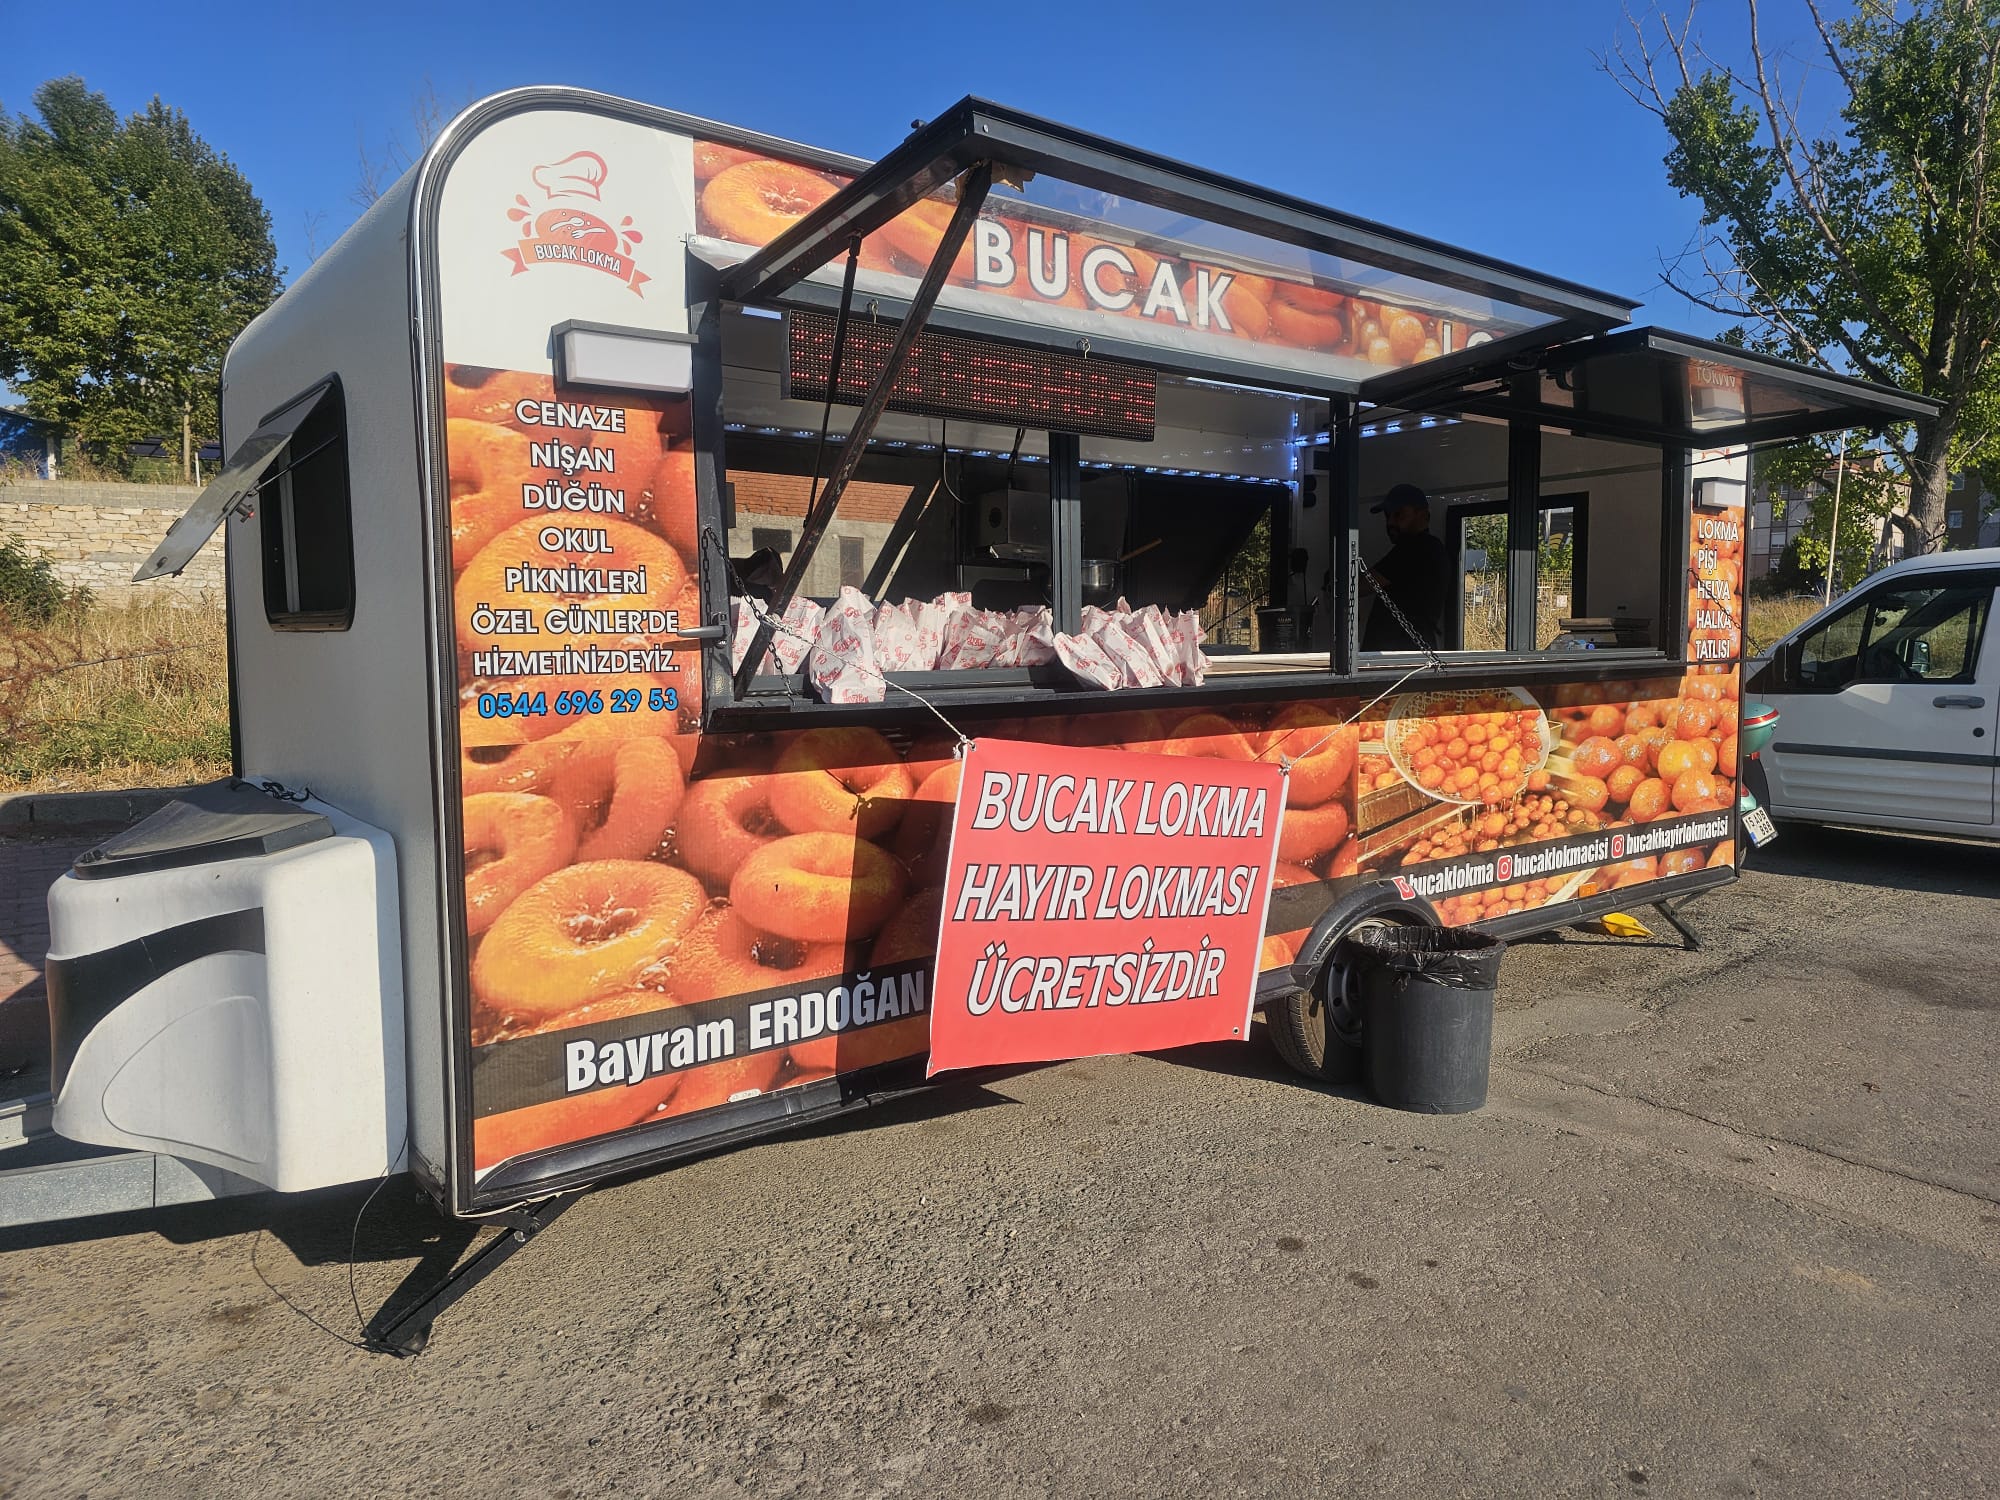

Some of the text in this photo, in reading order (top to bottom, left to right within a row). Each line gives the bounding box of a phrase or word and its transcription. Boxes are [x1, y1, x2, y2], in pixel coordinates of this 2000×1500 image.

[534, 243, 621, 275] BUCAK LOKMA
[974, 217, 1237, 331] BUCAK
[515, 399, 626, 433] CENAZE
[530, 438, 615, 476] NİŞAN
[522, 480, 625, 513] DÜĞÜN
[539, 527, 613, 553] OKUL
[1698, 518, 1739, 542] LOKMA
[1698, 544, 1717, 575] PİŞİ
[505, 561, 647, 594] PİKNİKLERİ
[1697, 579, 1730, 600] HELVA
[471, 603, 539, 634] ÖZEL
[1696, 609, 1732, 629] HALKA
[473, 644, 680, 676] HİZMETİNİZDEYİZ.
[1695, 639, 1730, 659] TATLISI
[478, 687, 679, 718] 0544 696 29 53
[971, 770, 1267, 838] BUCAK LOKMA
[1409, 815, 1728, 896] bucaklokma bucaklokmacisi bucakhayirlokmacisi
[952, 864, 1260, 921] HAYIR LOKMASI
[966, 935, 1226, 1016] ÜCRETSİZDİR
[564, 971, 925, 1092] Bayram ERDOĞAN
